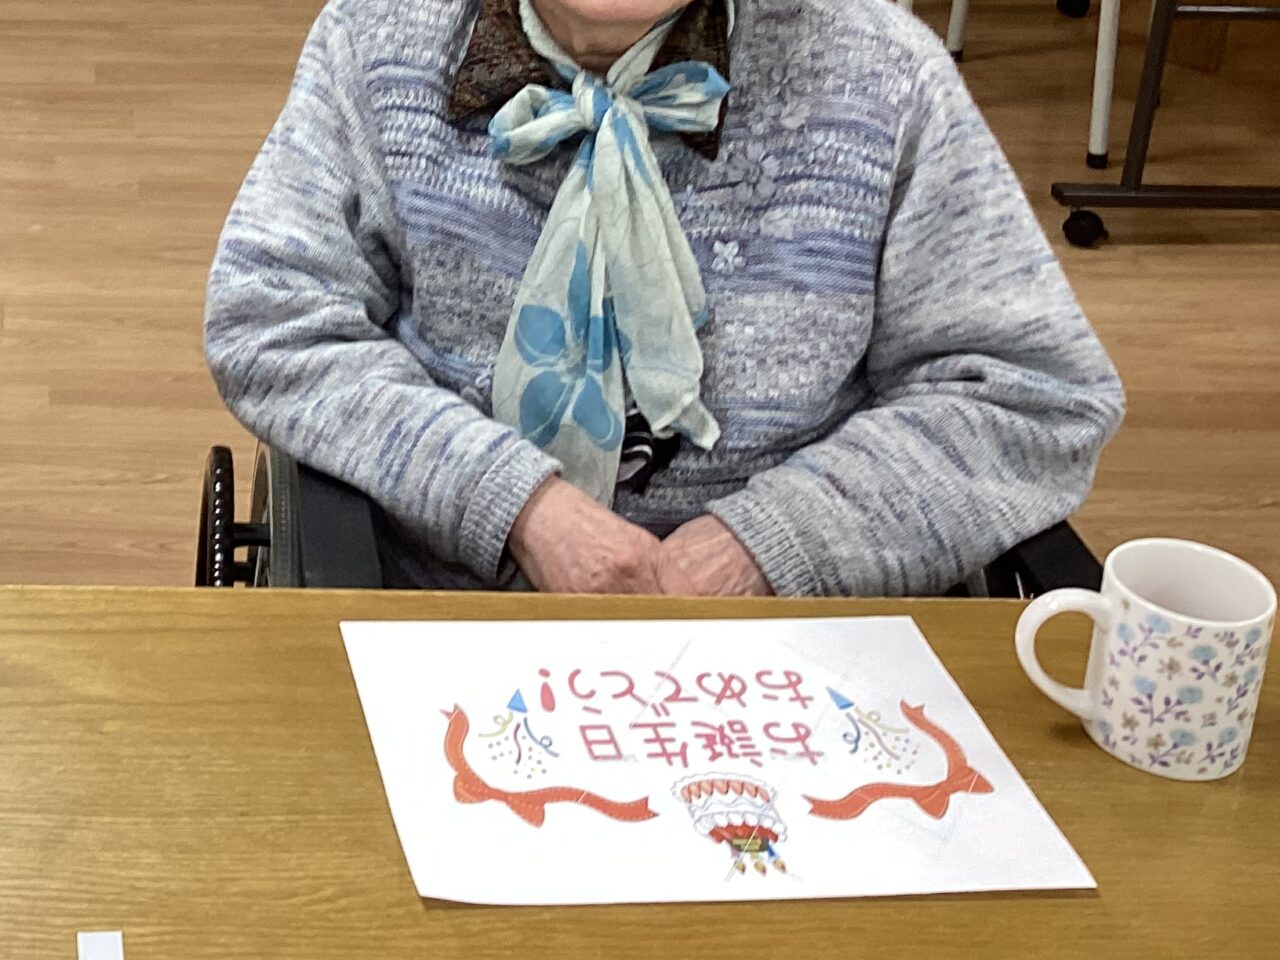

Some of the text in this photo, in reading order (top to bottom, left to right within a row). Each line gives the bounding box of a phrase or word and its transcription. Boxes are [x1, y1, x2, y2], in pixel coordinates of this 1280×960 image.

[538, 668, 815, 716] おめでとう!
[578, 719, 824, 768] お誕生日
